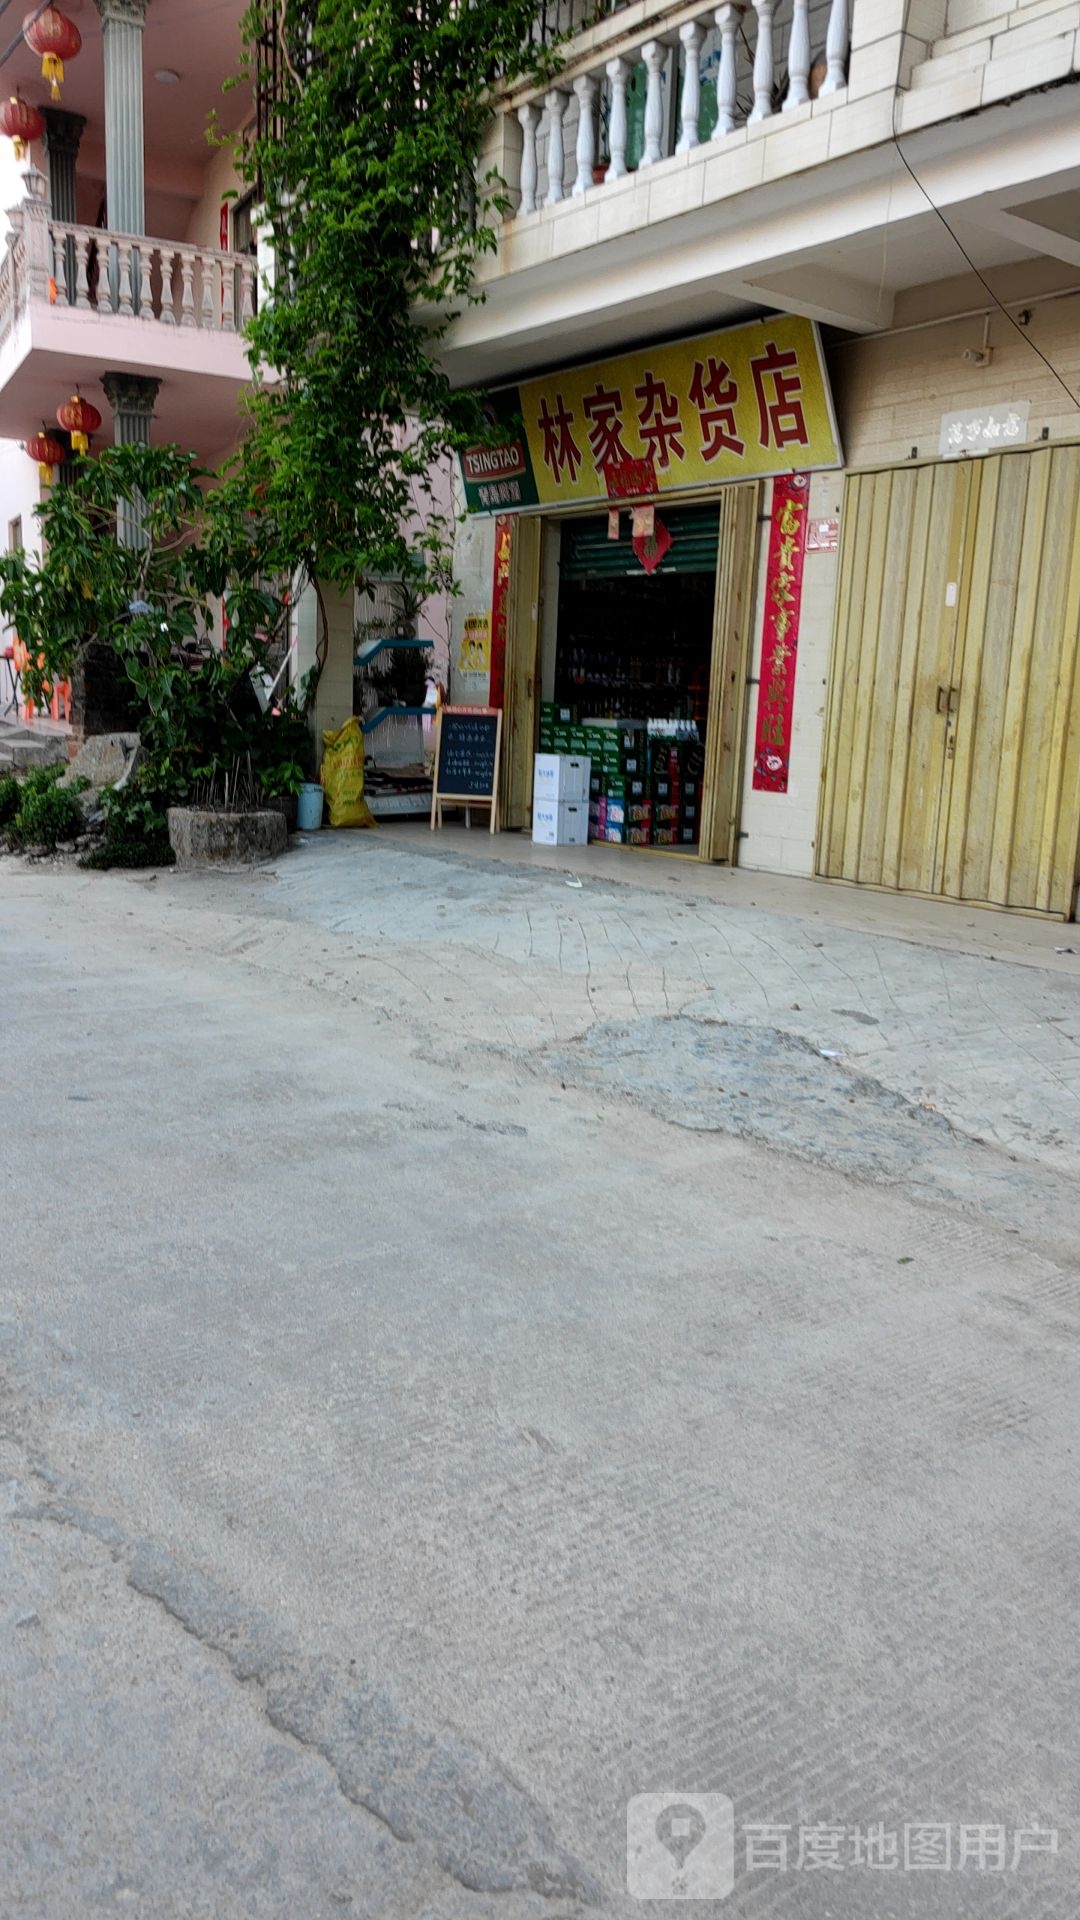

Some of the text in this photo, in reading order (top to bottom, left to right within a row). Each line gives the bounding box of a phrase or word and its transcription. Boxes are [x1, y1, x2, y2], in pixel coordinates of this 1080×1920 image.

[538, 342, 809, 485] 林家杂货店
[465, 446, 520, 474] TSINGTAO
